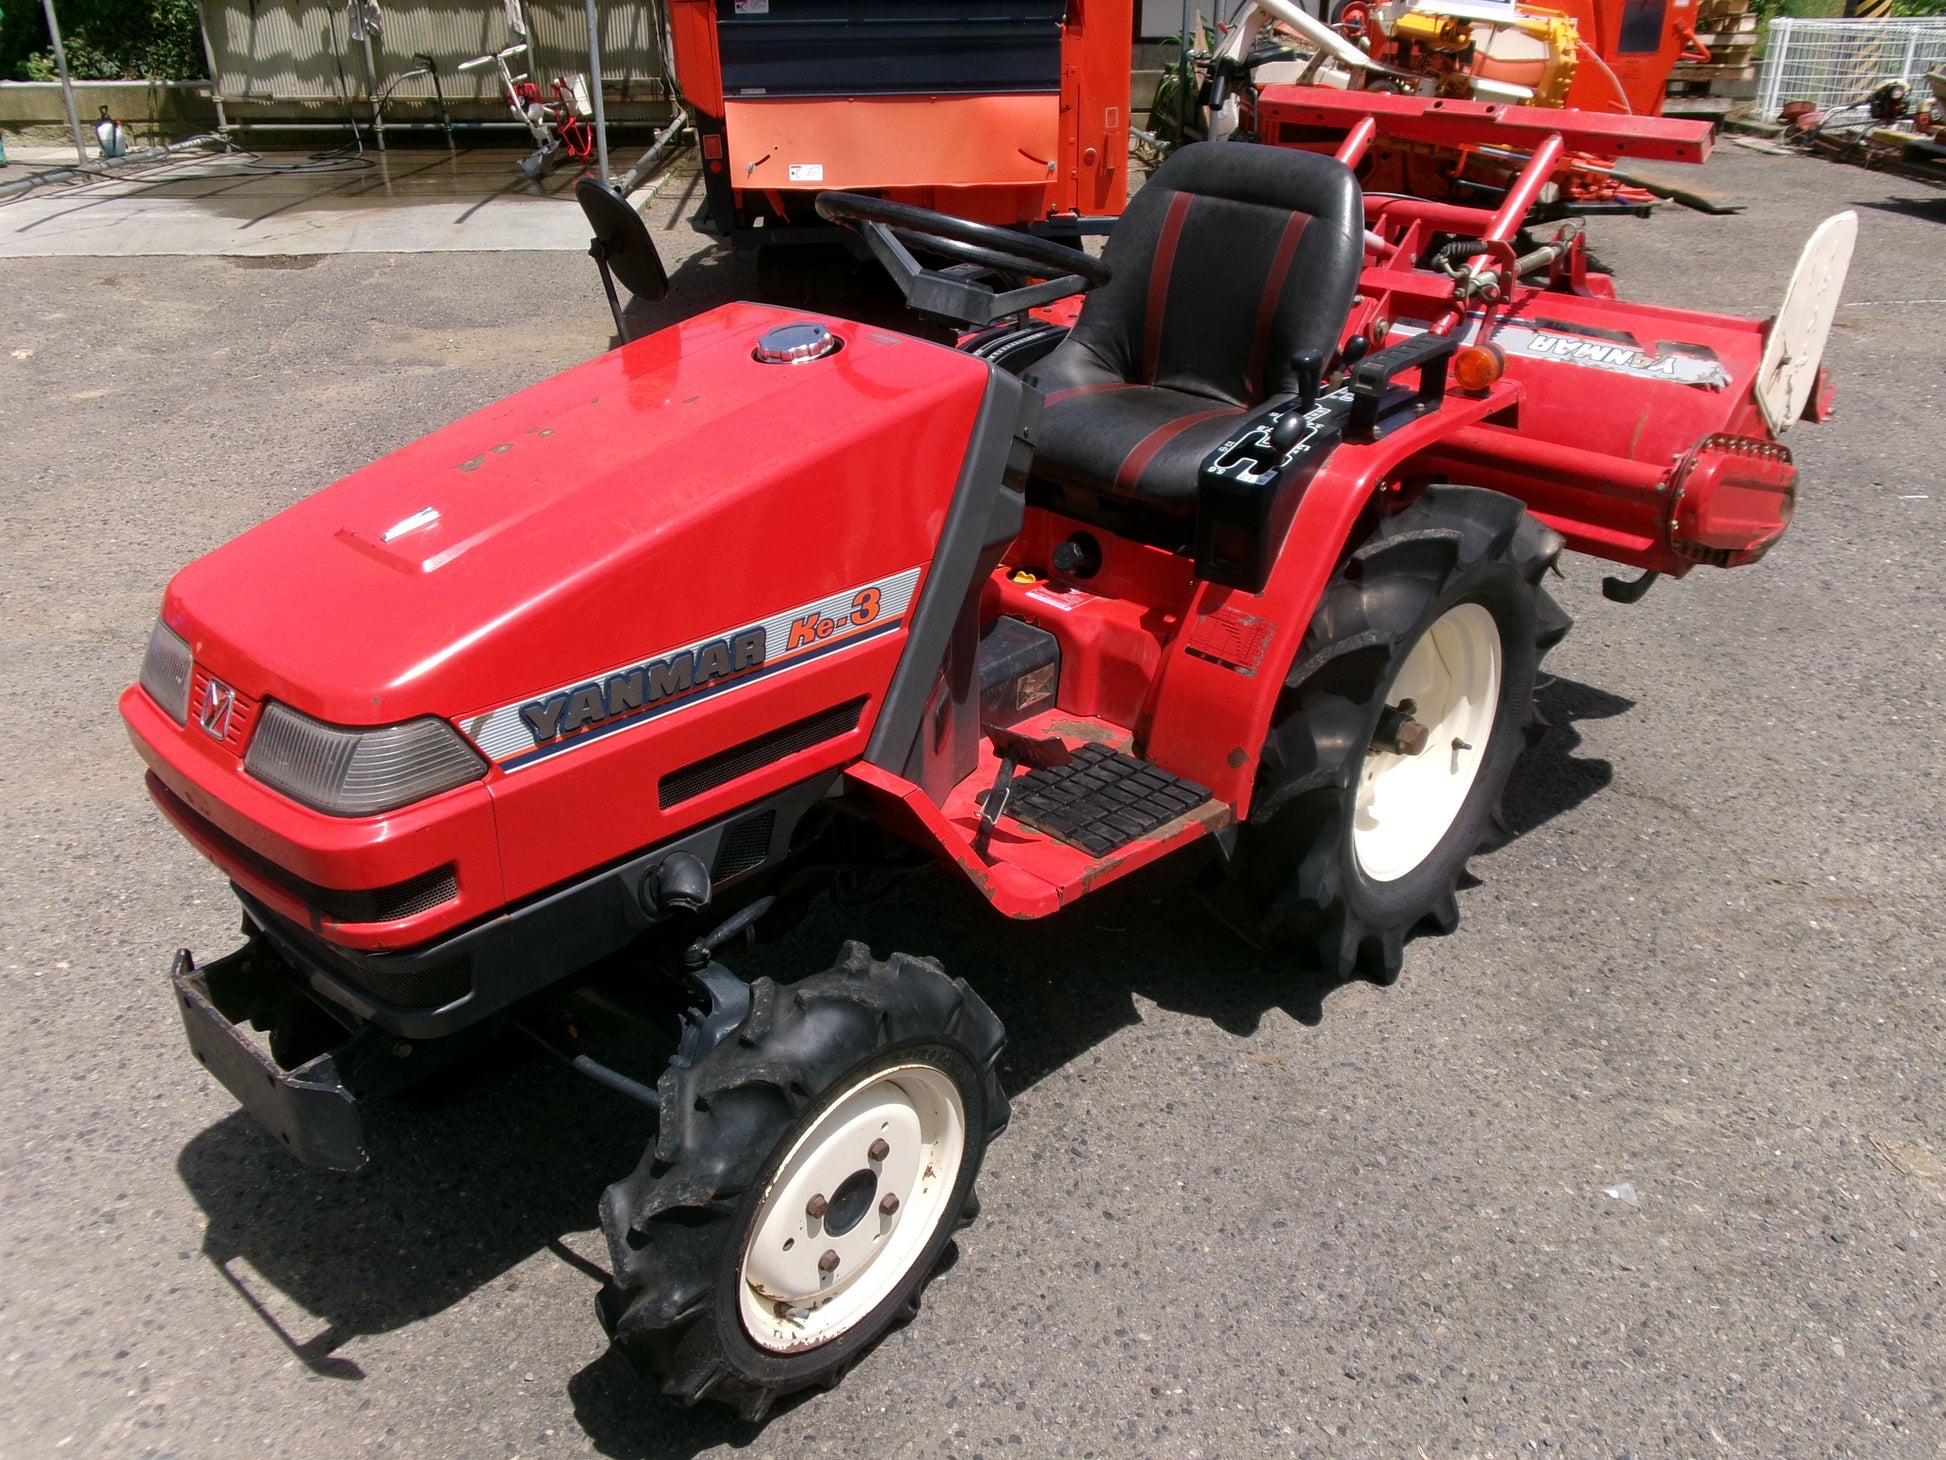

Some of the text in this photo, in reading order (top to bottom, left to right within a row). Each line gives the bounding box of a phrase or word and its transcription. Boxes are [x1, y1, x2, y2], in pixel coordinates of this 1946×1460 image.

[1528, 334, 1676, 375] YANMAR
[520, 587, 882, 741] YANMAR Ke-3
